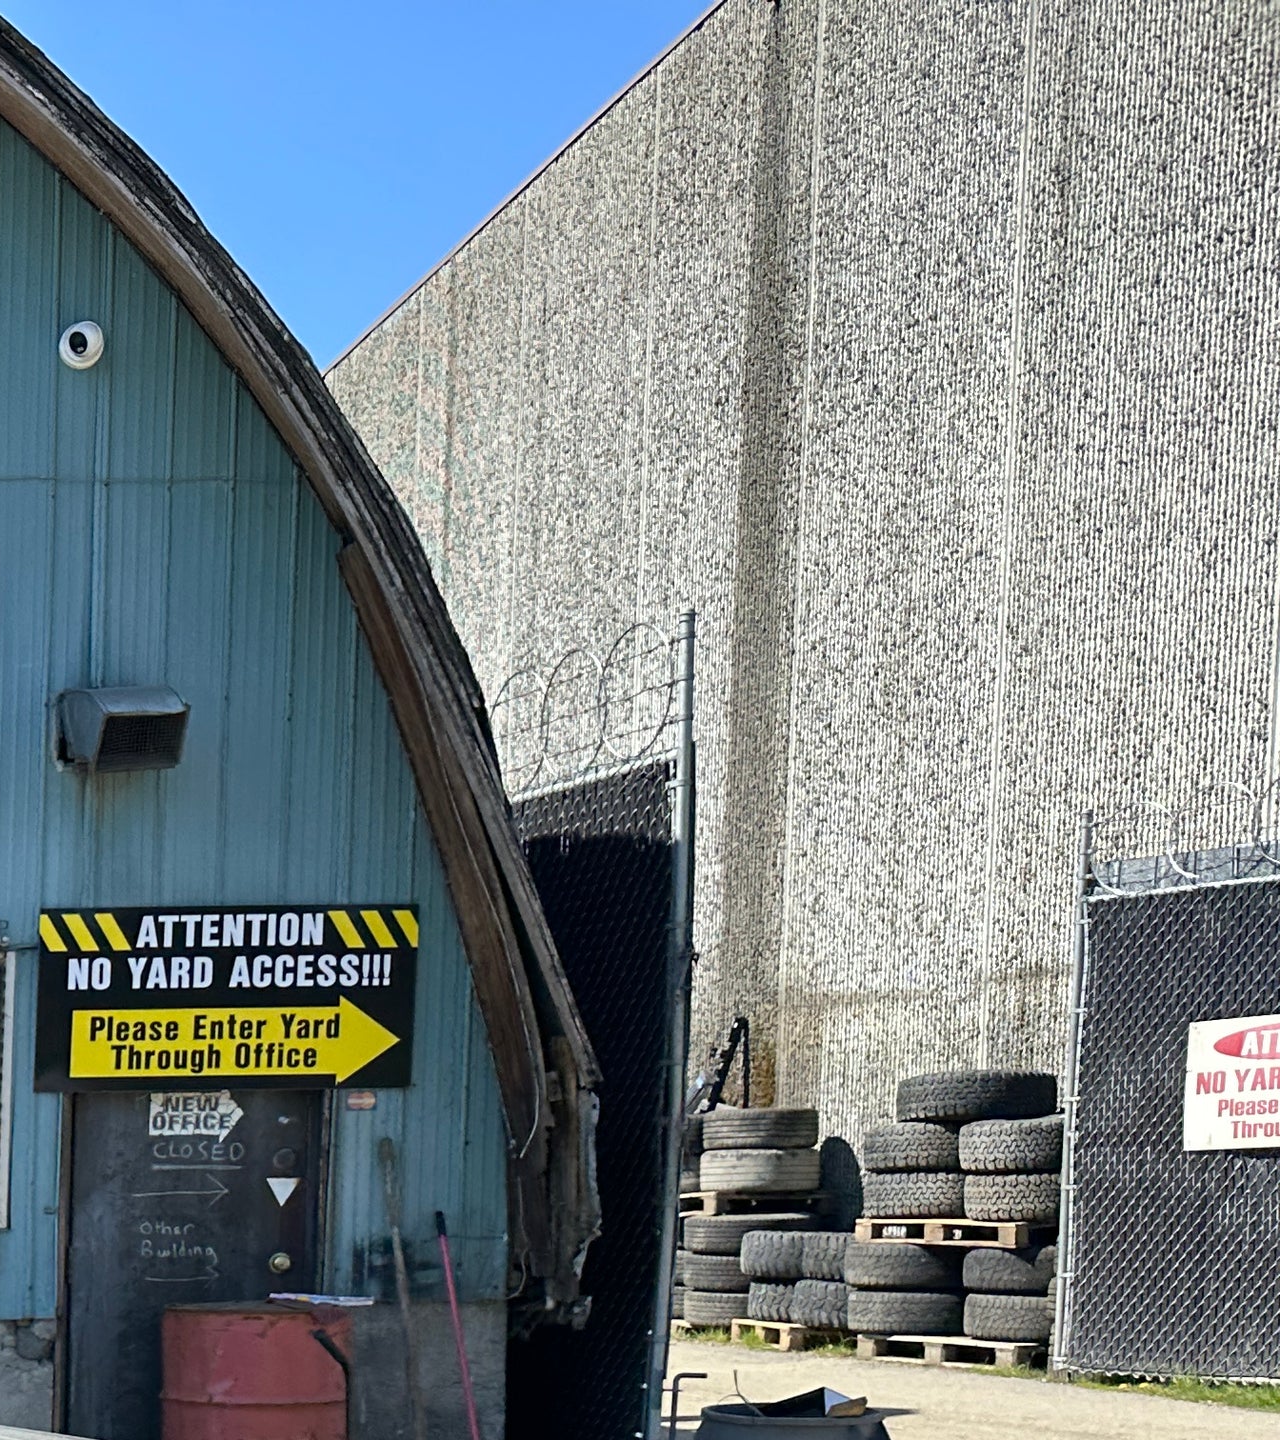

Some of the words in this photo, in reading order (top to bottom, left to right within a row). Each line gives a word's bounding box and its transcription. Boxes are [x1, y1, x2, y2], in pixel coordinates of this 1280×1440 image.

[135, 912, 324, 948] ATTENTION
[67, 957, 111, 990] NO
[128, 955, 213, 989] YARD
[229, 953, 392, 988] ACCESS!!!
[90, 1016, 179, 1042] Please
[193, 1015, 266, 1040] Enter
[281, 1013, 340, 1039] Yard
[111, 1044, 221, 1073] Through
[235, 1043, 317, 1069] Office
[1196, 1071, 1226, 1095] NO
[164, 1094, 219, 1112] NEW
[1218, 1099, 1279, 1117] Please
[152, 1112, 232, 1131] OFFICE
